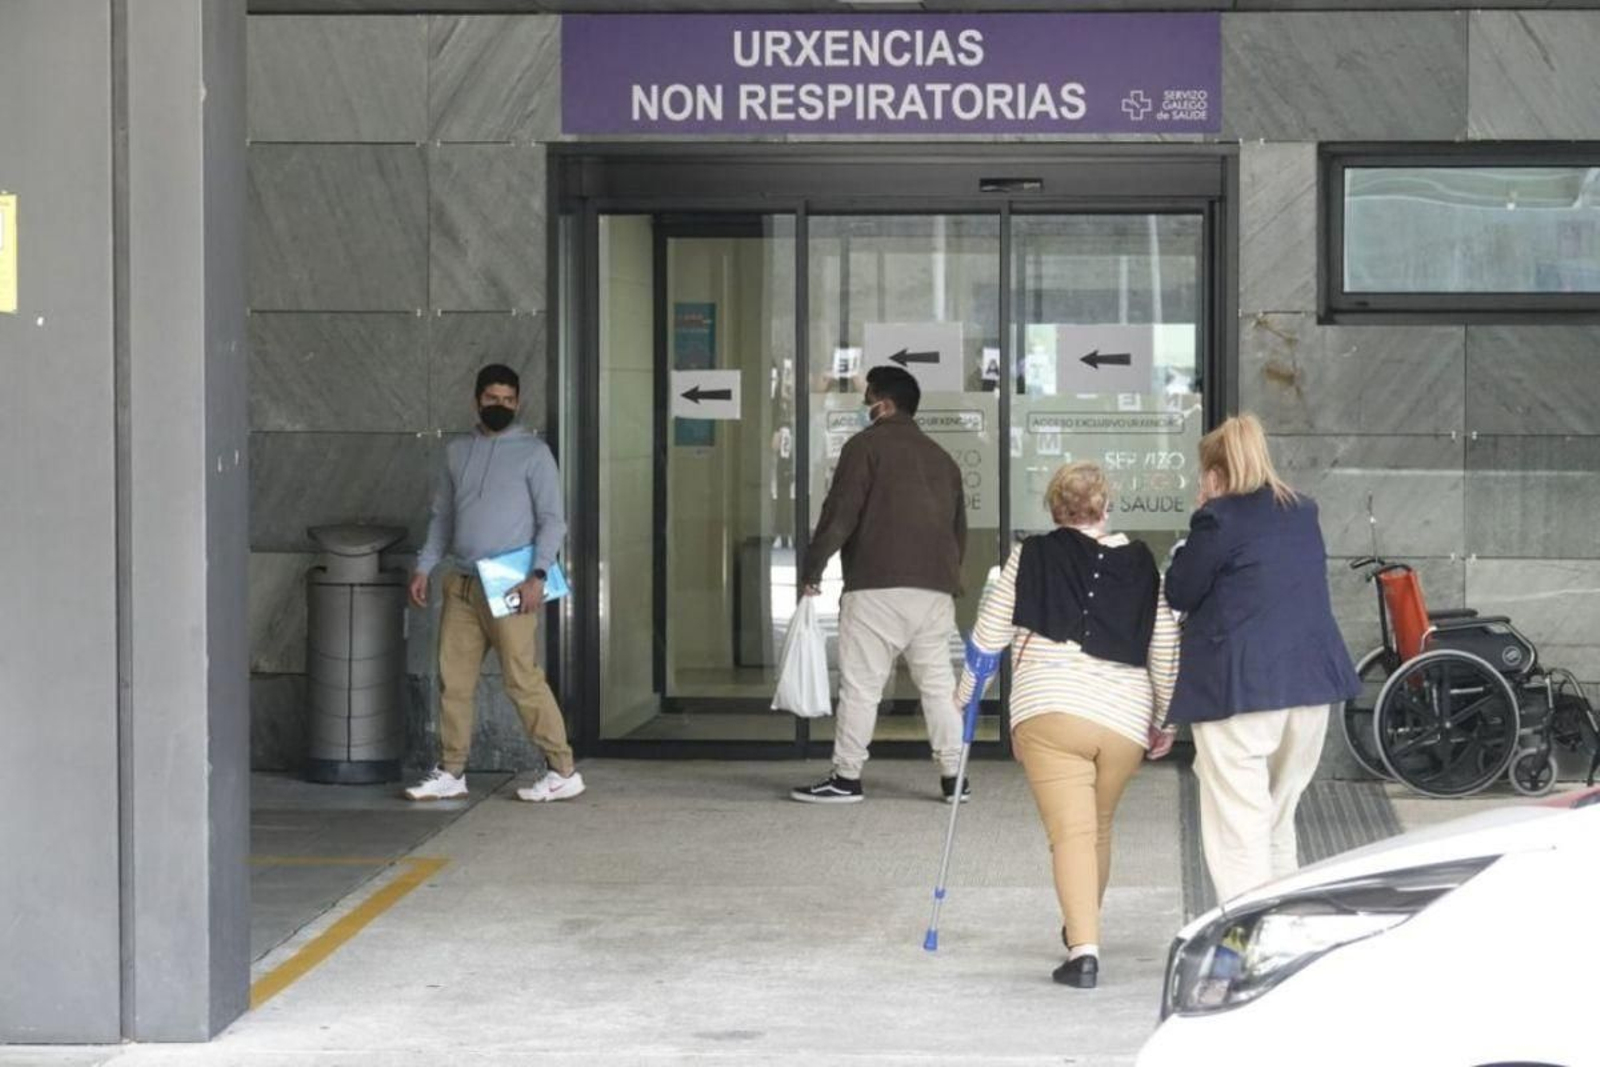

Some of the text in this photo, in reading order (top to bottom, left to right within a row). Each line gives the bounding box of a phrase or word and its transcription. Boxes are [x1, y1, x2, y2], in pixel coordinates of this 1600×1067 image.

[734, 29, 983, 67] URXENCIAS
[632, 83, 1086, 120] NON RESPIRATORIAS
[1163, 90, 1207, 100] SERVIZO
[1162, 100, 1207, 110] GALEGO
[1156, 109, 1207, 120] de SAUDE
[1120, 496, 1184, 513] SAUDE
